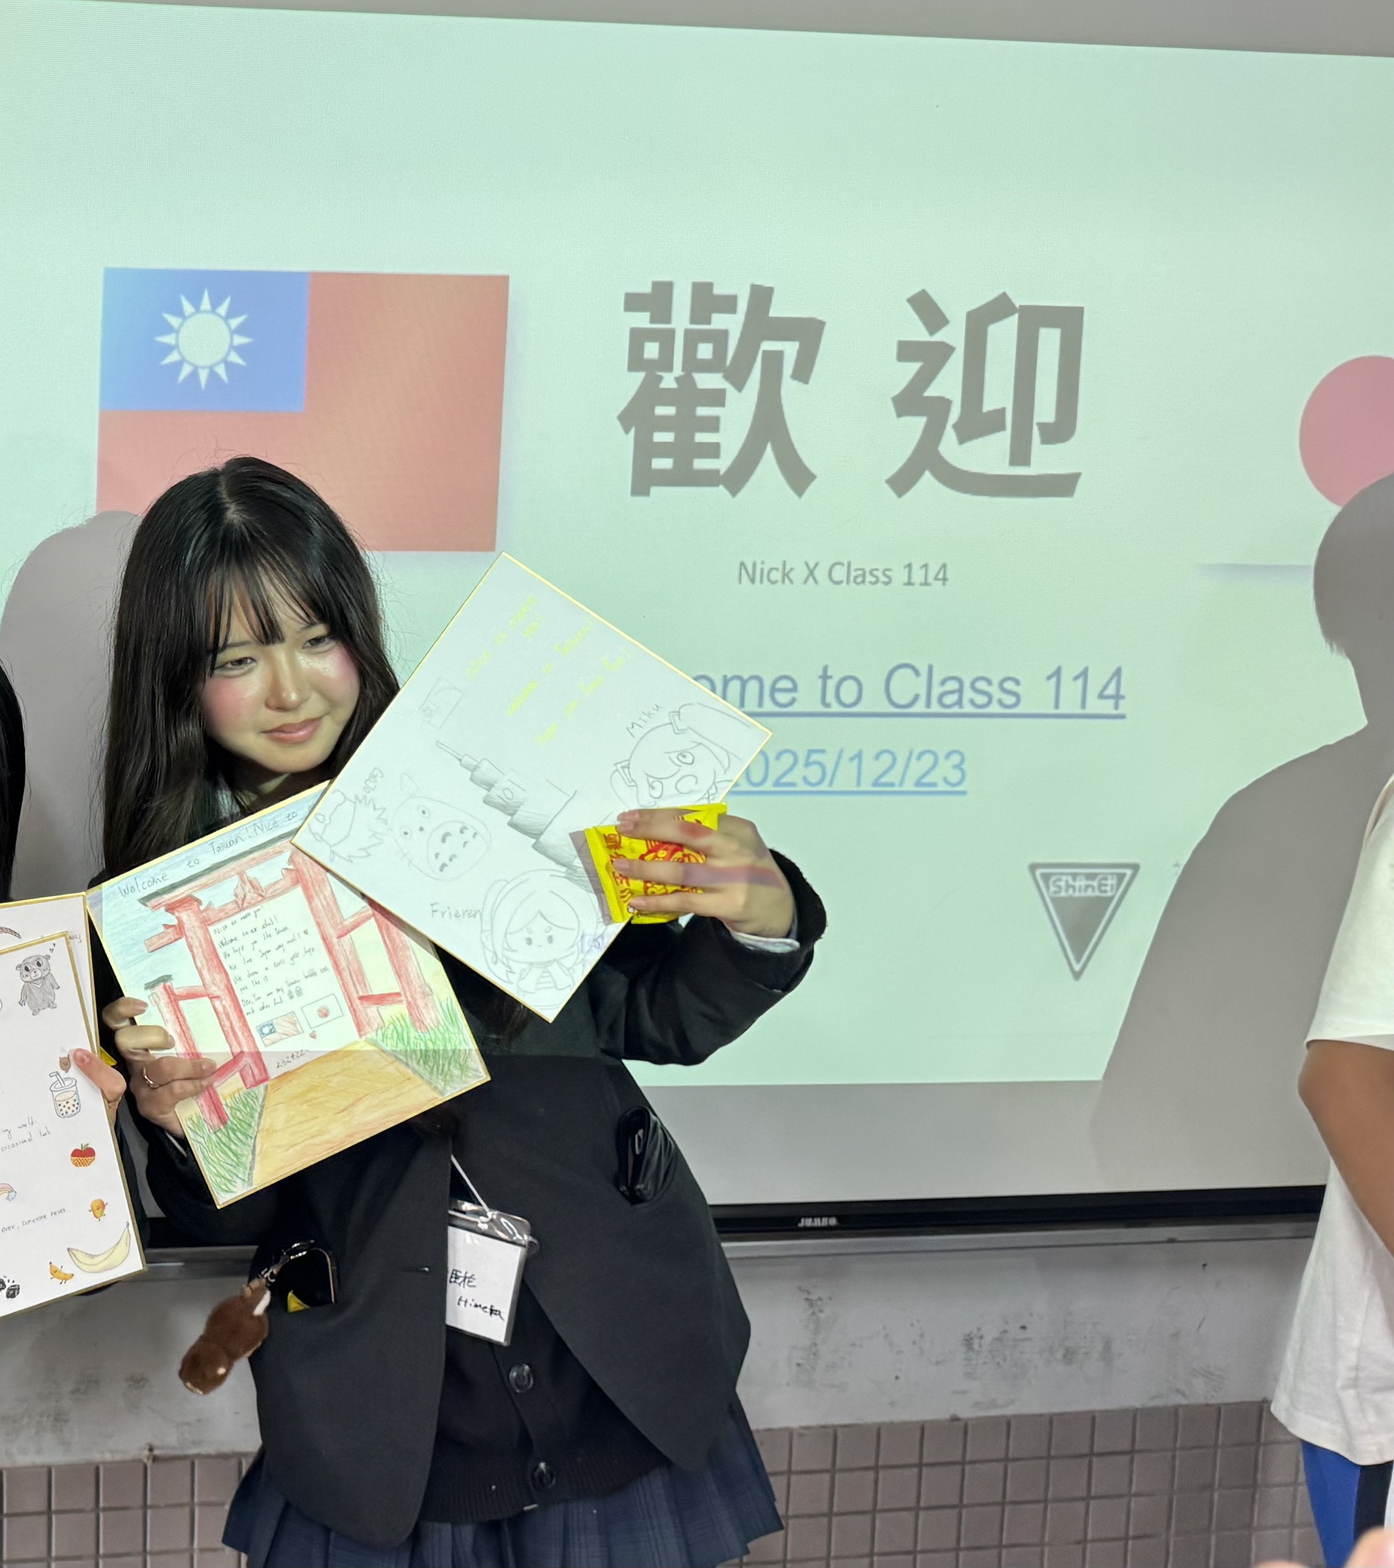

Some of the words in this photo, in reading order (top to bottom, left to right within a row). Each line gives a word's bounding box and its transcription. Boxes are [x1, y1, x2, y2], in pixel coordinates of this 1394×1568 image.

[737, 559, 794, 587] Nick
[802, 562, 820, 587] X
[827, 560, 893, 588] Class
[902, 563, 950, 588] 114
[818, 664, 863, 709] to
[883, 662, 1022, 710] Class
[1045, 666, 1127, 711] 114
[625, 703, 663, 738] Miku
[736, 747, 967, 790] 025/12/23
[118, 873, 170, 898] Welcome
[187, 858, 200, 868] to
[286, 811, 298, 821] to
[430, 902, 483, 919] Frieren
